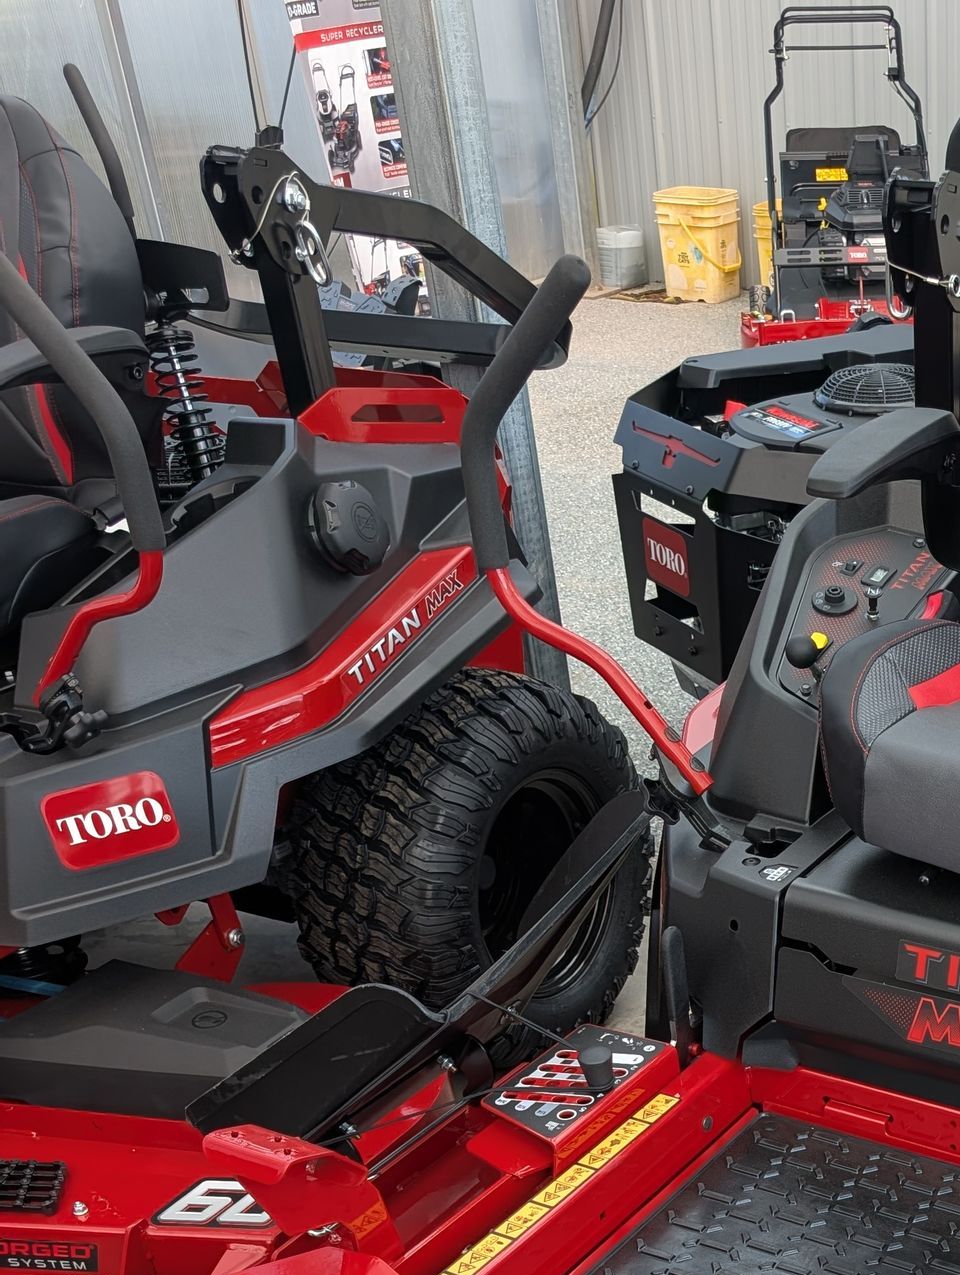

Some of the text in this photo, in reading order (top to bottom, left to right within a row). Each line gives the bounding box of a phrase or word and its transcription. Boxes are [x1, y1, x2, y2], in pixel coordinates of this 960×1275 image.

[321, 25, 384, 42] SUPER RECYCLER
[646, 537, 685, 576] TORO
[347, 568, 464, 685] TITAN MAX
[56, 797, 164, 846] TORO
[8, 1258, 87, 1270] SYSTEM
